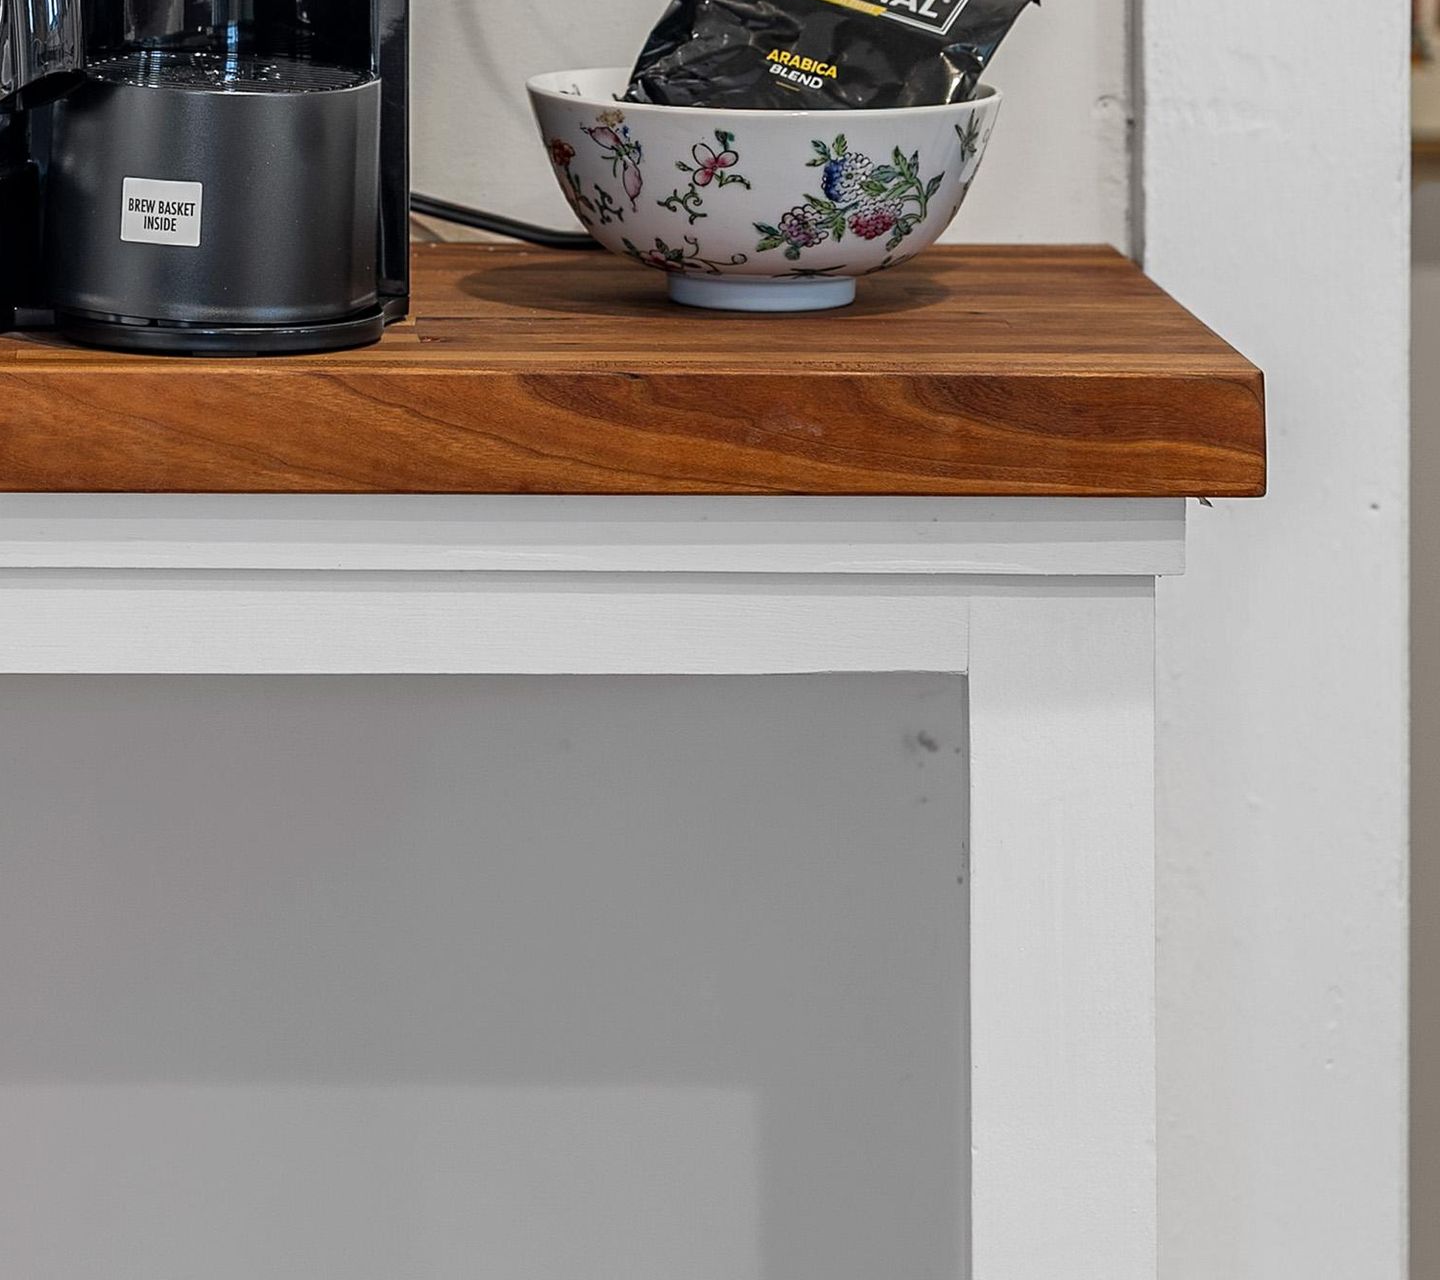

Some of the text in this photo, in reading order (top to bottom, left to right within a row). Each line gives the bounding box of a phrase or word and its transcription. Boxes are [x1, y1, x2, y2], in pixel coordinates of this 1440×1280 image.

[766, 49, 838, 79] ARABICA
[769, 63, 823, 89] BLEND
[128, 198, 196, 217] BREW BASKET
[143, 216, 177, 232] INSIDE
